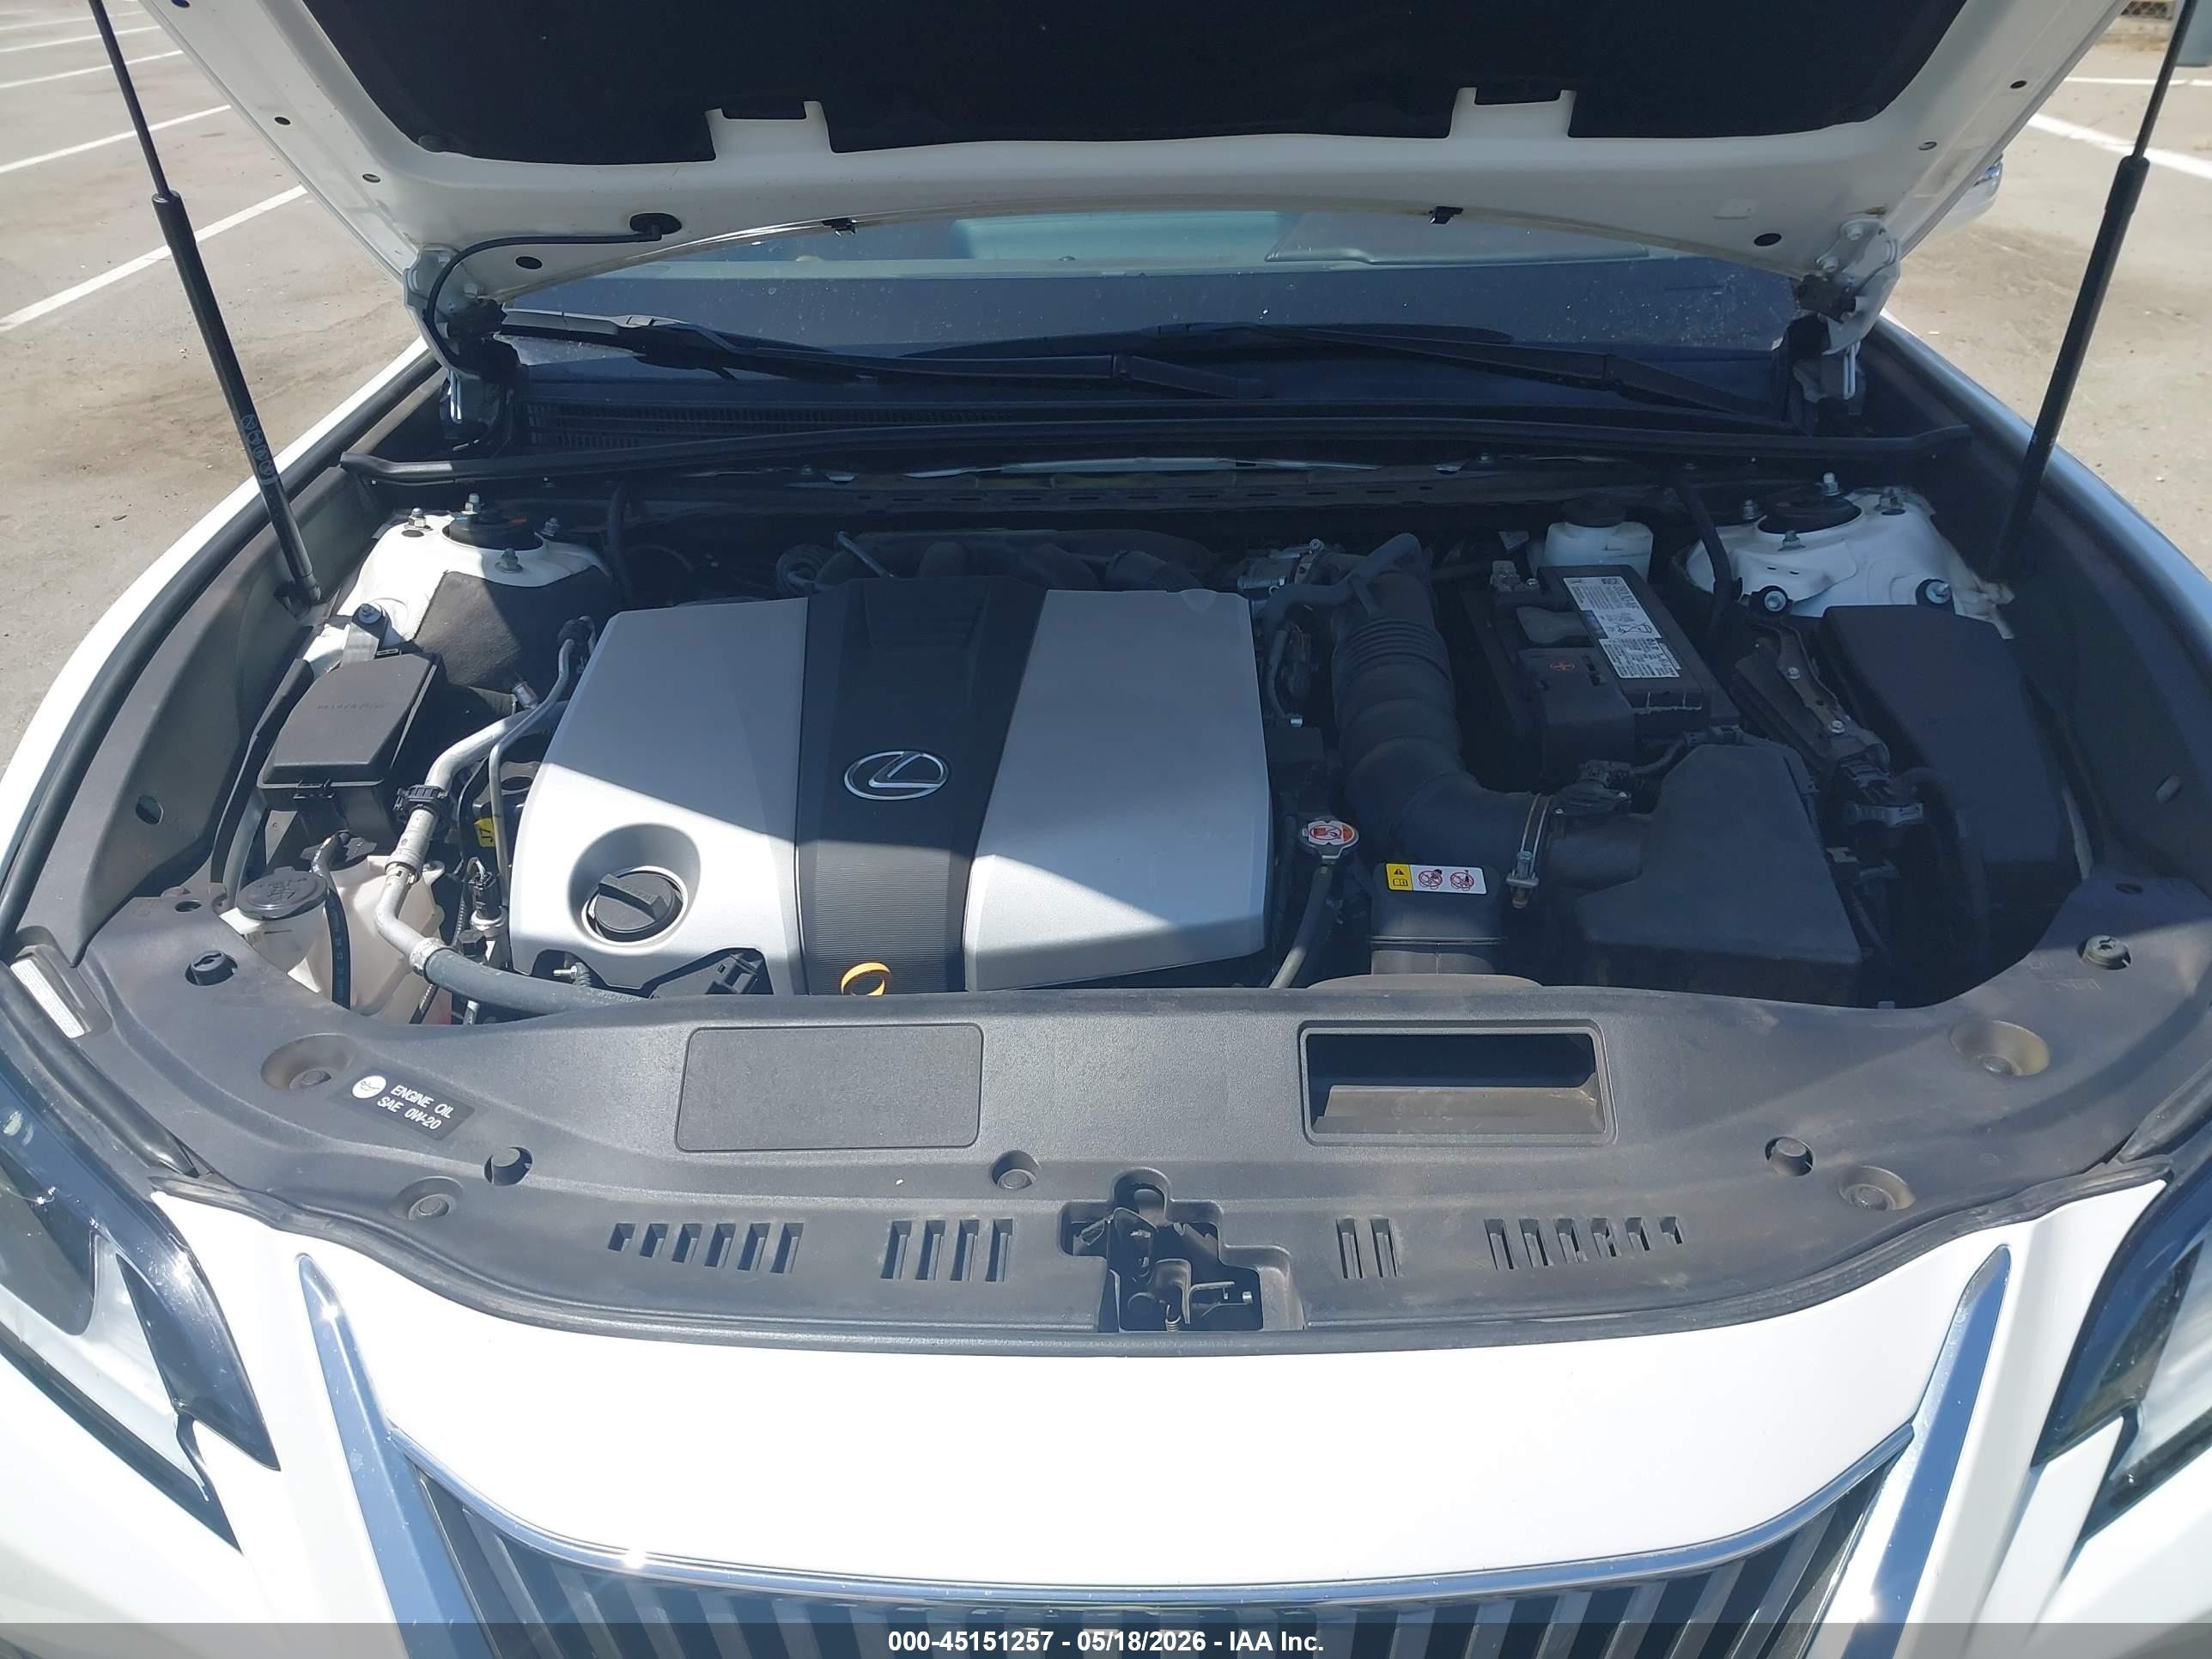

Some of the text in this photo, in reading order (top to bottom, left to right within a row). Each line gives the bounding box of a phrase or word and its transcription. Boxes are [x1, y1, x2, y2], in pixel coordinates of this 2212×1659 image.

[377, 1097, 442, 1130] SAE 0W-20
[390, 1085, 455, 1119] ENGINE OIL
